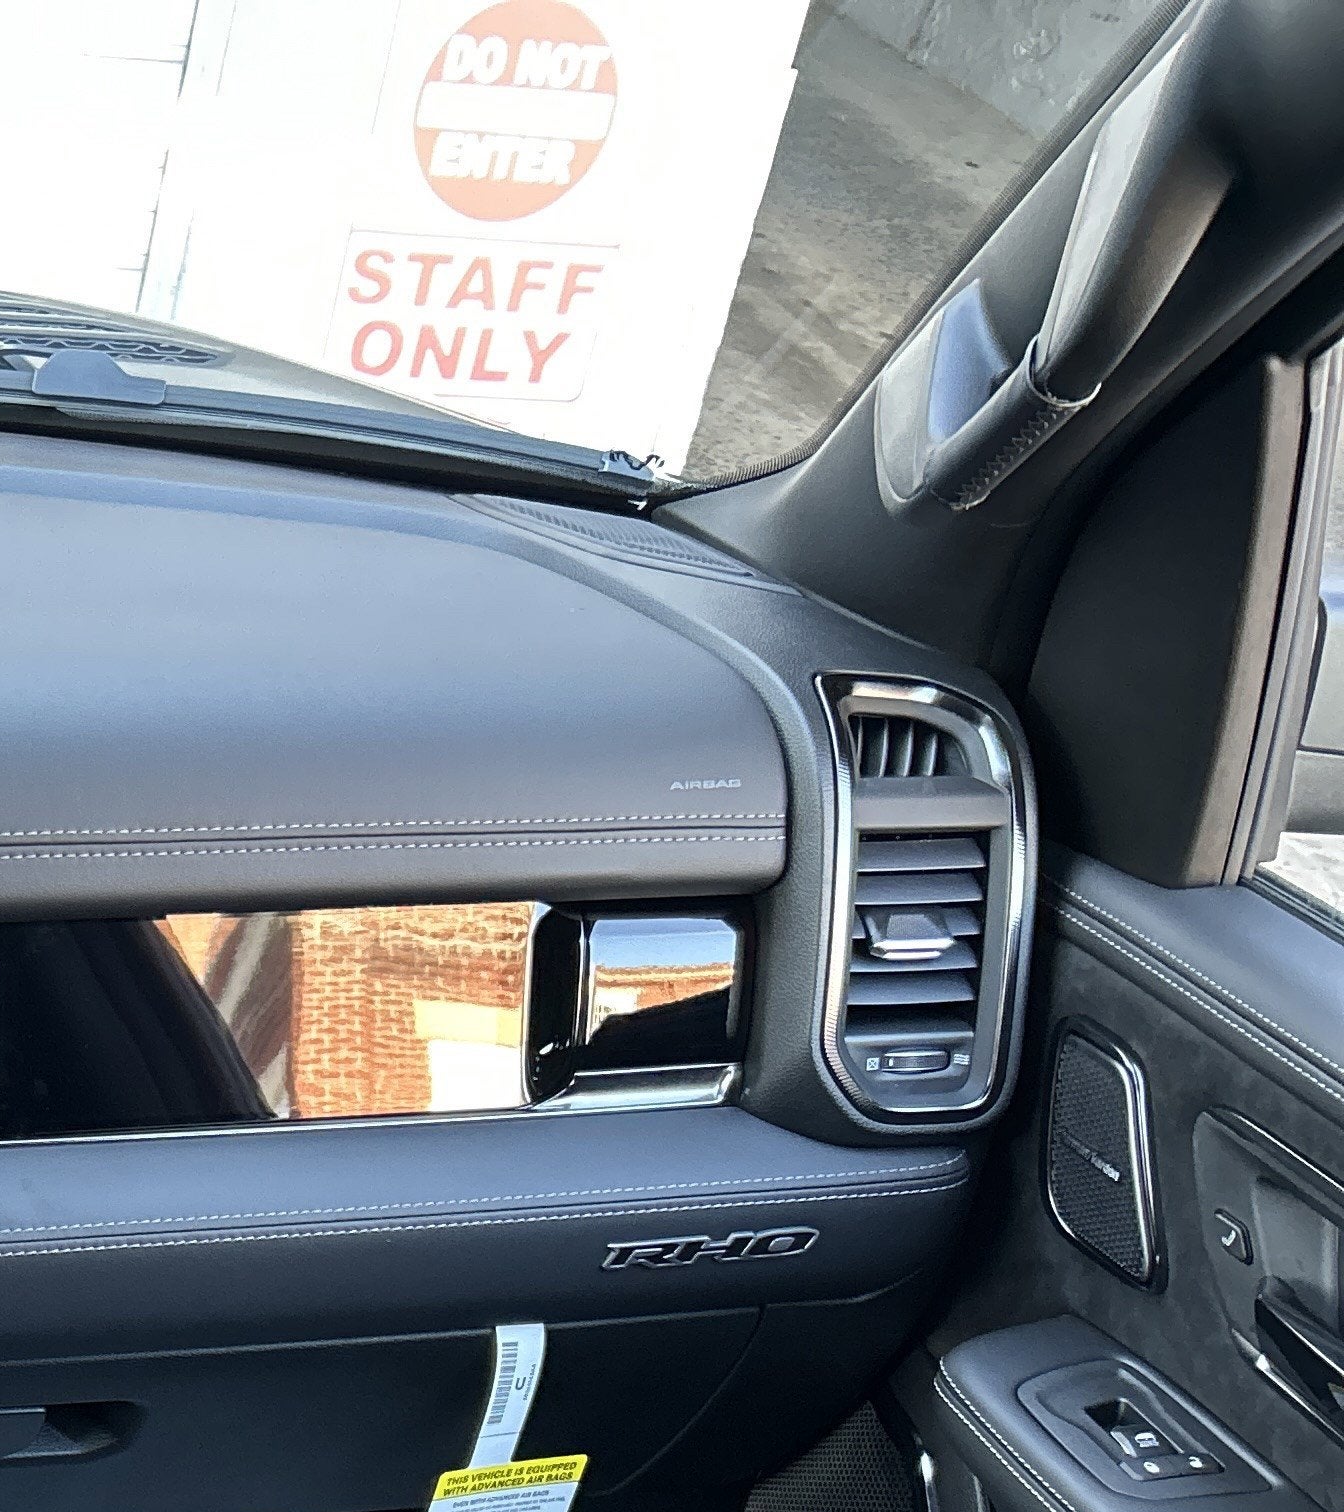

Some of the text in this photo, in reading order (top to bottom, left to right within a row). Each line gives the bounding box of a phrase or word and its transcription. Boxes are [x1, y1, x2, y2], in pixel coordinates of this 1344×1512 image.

[442, 33, 611, 90] DO NOT
[429, 130, 576, 185] ENTER
[347, 249, 605, 315] STAFF
[350, 320, 572, 384] ONLY
[669, 778, 742, 791] AIRBAG
[600, 1226, 820, 1271] RHO
[443, 1471, 574, 1498] WITH ADVANCED AIR BAGS
[446, 1461, 578, 1486] THIS VEHICLE IS EQUIPPED
